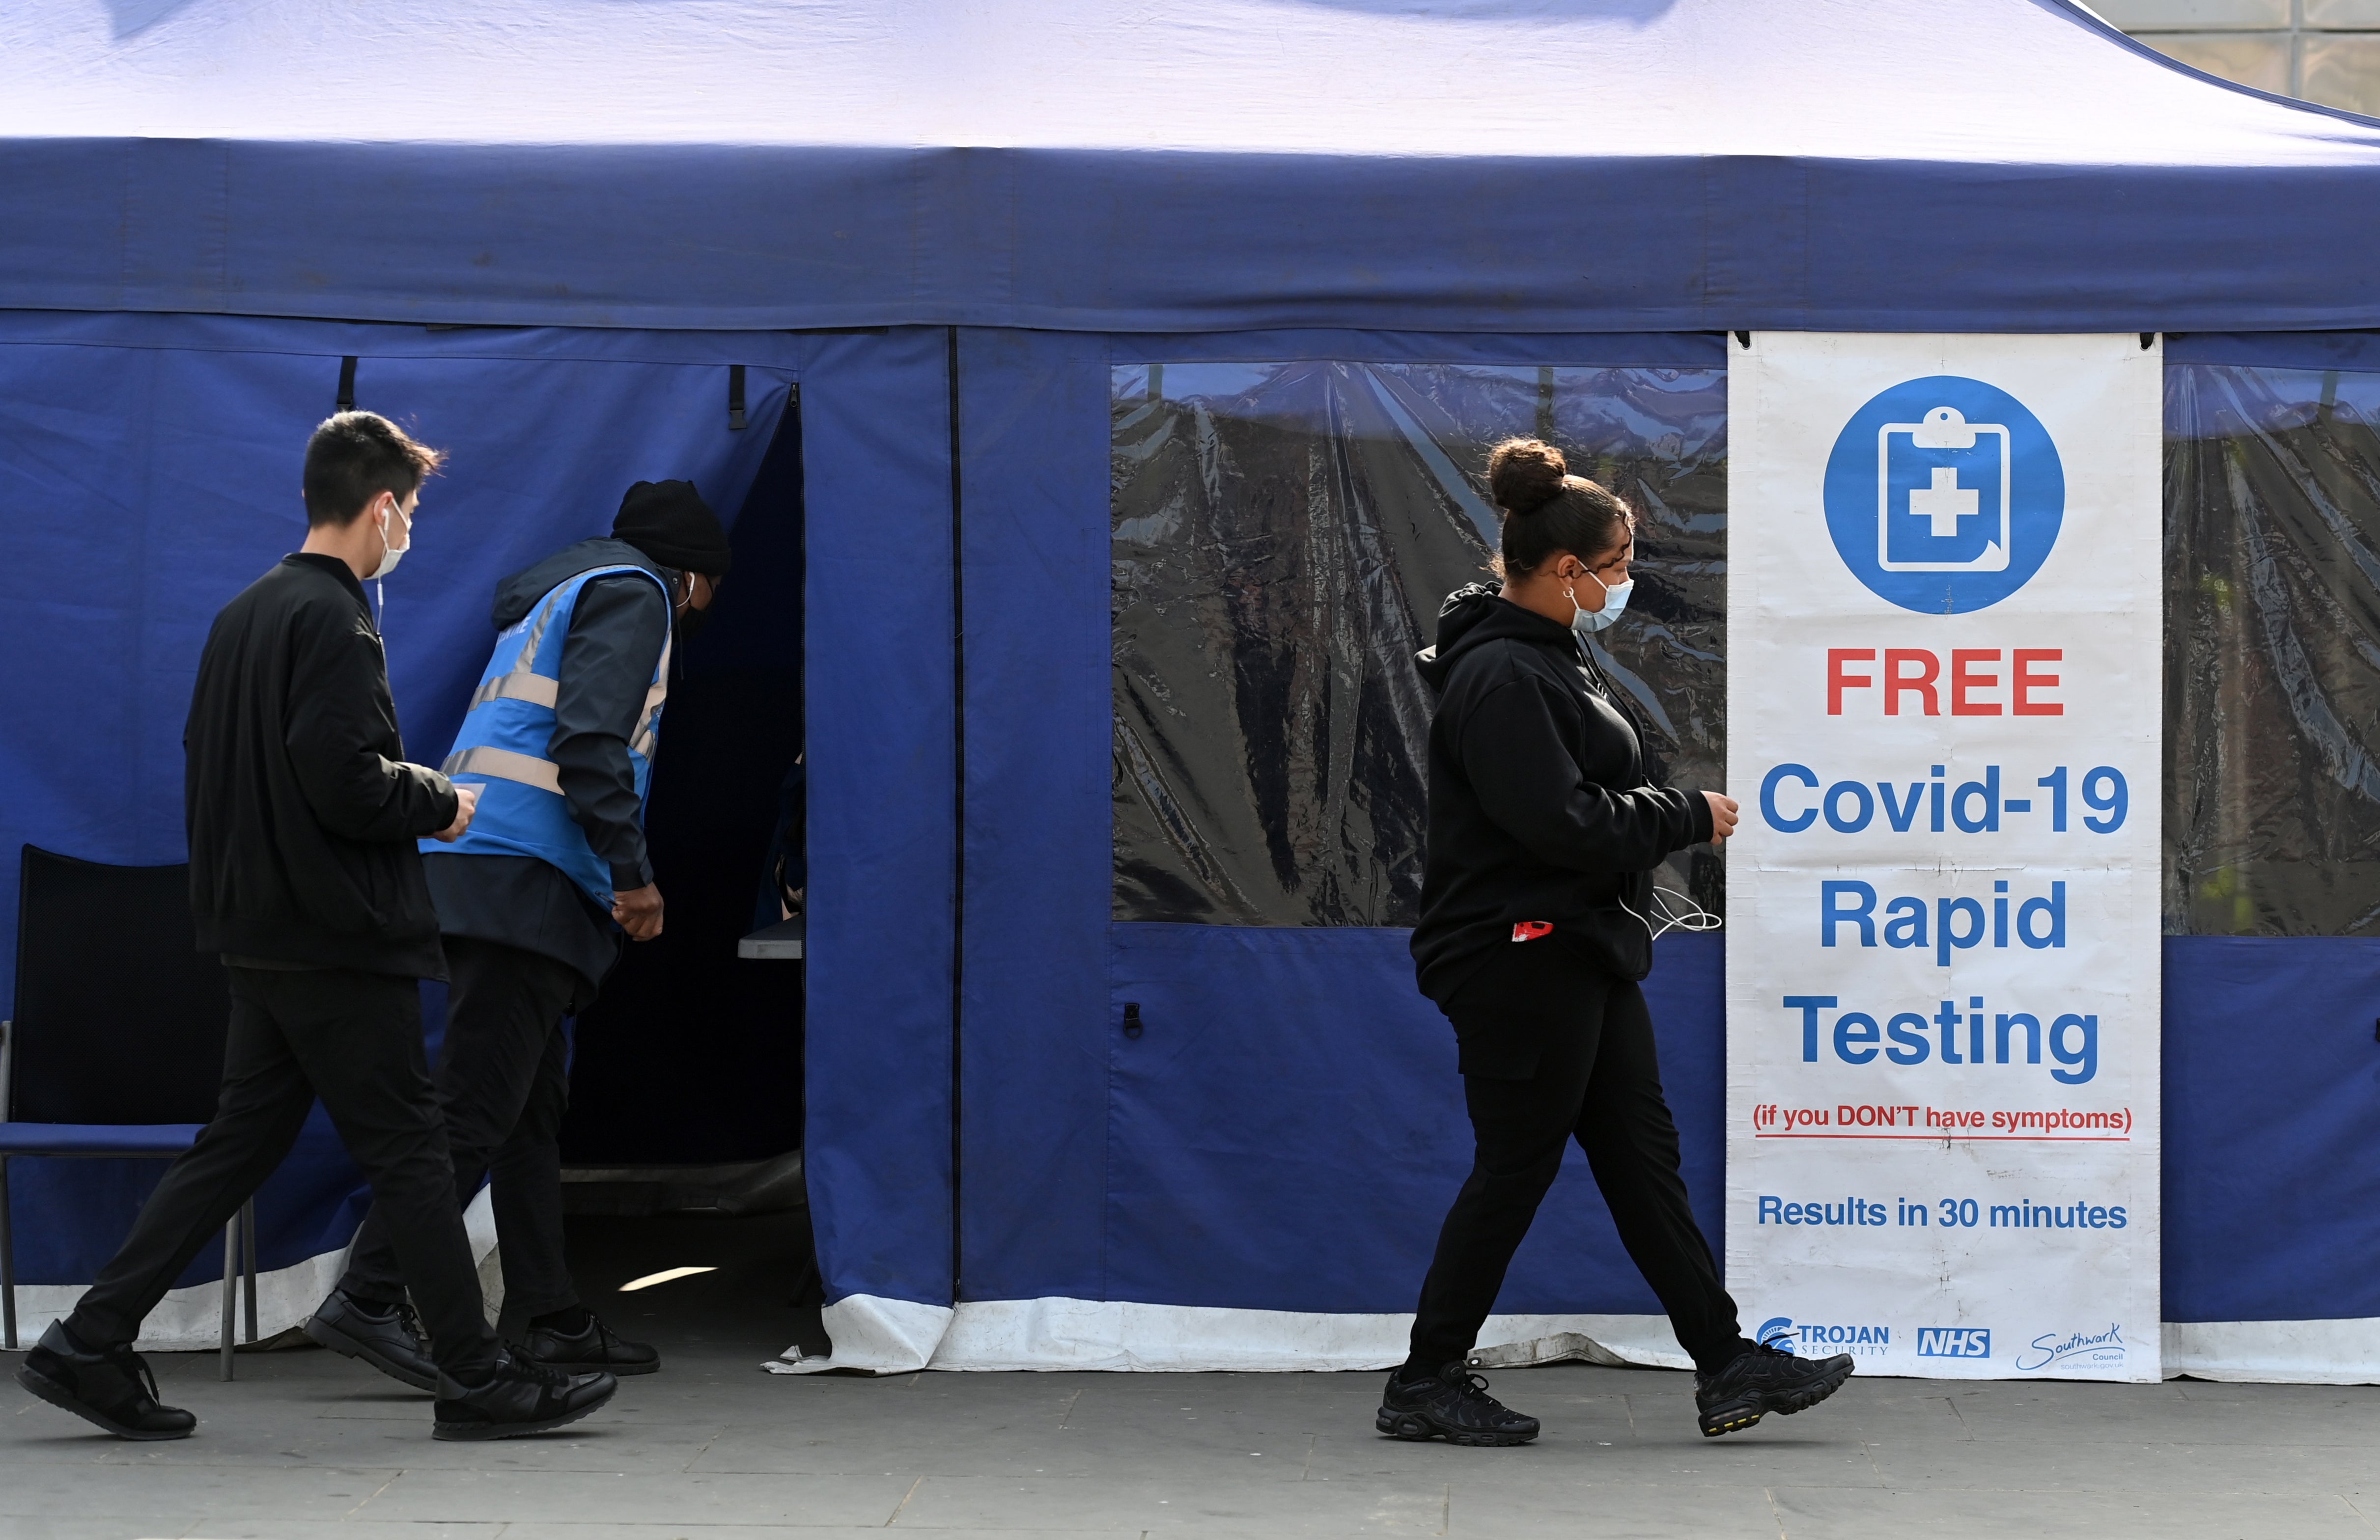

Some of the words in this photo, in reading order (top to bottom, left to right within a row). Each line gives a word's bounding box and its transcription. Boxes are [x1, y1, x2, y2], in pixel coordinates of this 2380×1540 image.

[1827, 648, 2064, 716] FREE
[1760, 763, 2129, 834] Covid-19
[1821, 880, 2066, 967] Rapid
[1783, 996, 2098, 1085] Testing
[1753, 1104, 1777, 1131] (if
[1783, 1110, 1829, 1131] you
[1838, 1105, 1920, 1127] DON’T
[1926, 1107, 1985, 1128] have
[1992, 1108, 2132, 1134] symptoms)
[1759, 1196, 1888, 1226] Results
[1899, 1197, 1929, 1227] in
[1939, 1198, 1980, 1228] 30
[1990, 1199, 2128, 1229] minutes
[1797, 1325, 1889, 1344] TROJAN
[1801, 1345, 1888, 1356] SECURITY
[1919, 1330, 1988, 1356] NHS
[2016, 1322, 2123, 1371] Southwark
[2060, 1362, 2124, 1371] southwark.gov.uk
